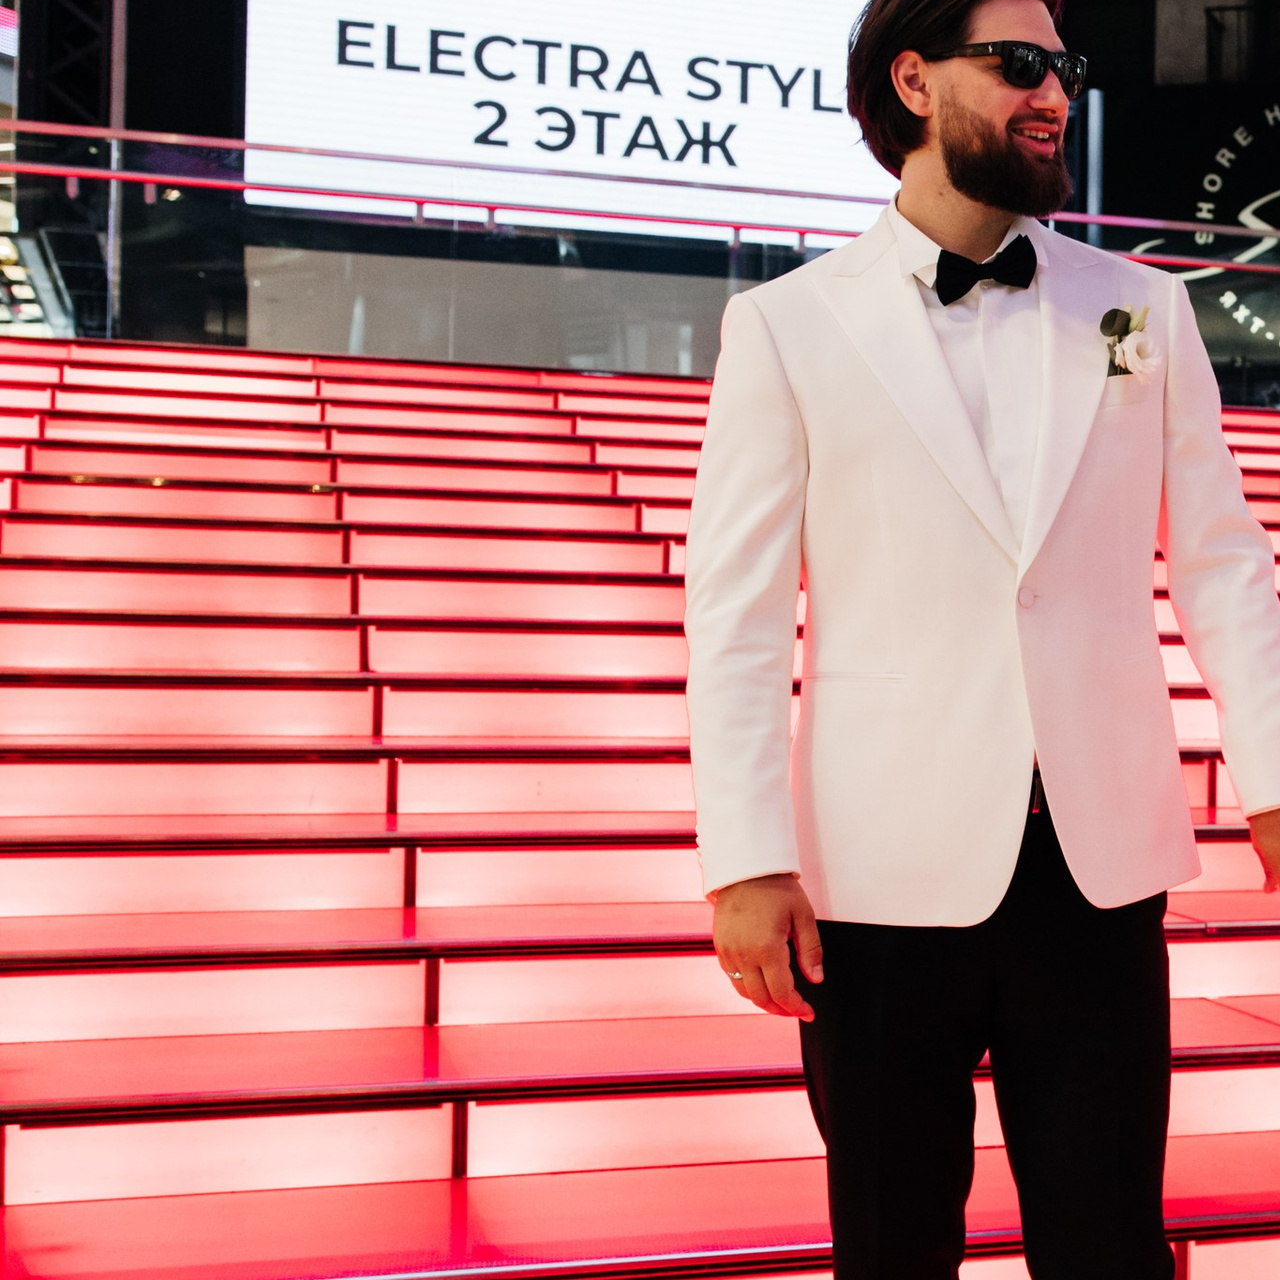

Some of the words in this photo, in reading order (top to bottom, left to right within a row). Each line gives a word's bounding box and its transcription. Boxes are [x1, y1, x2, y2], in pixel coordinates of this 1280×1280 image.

[336, 18, 661, 97] ELECTRA
[686, 56, 843, 115] STYL
[473, 99, 509, 149] 2
[535, 109, 739, 167] ЭТАЖ
